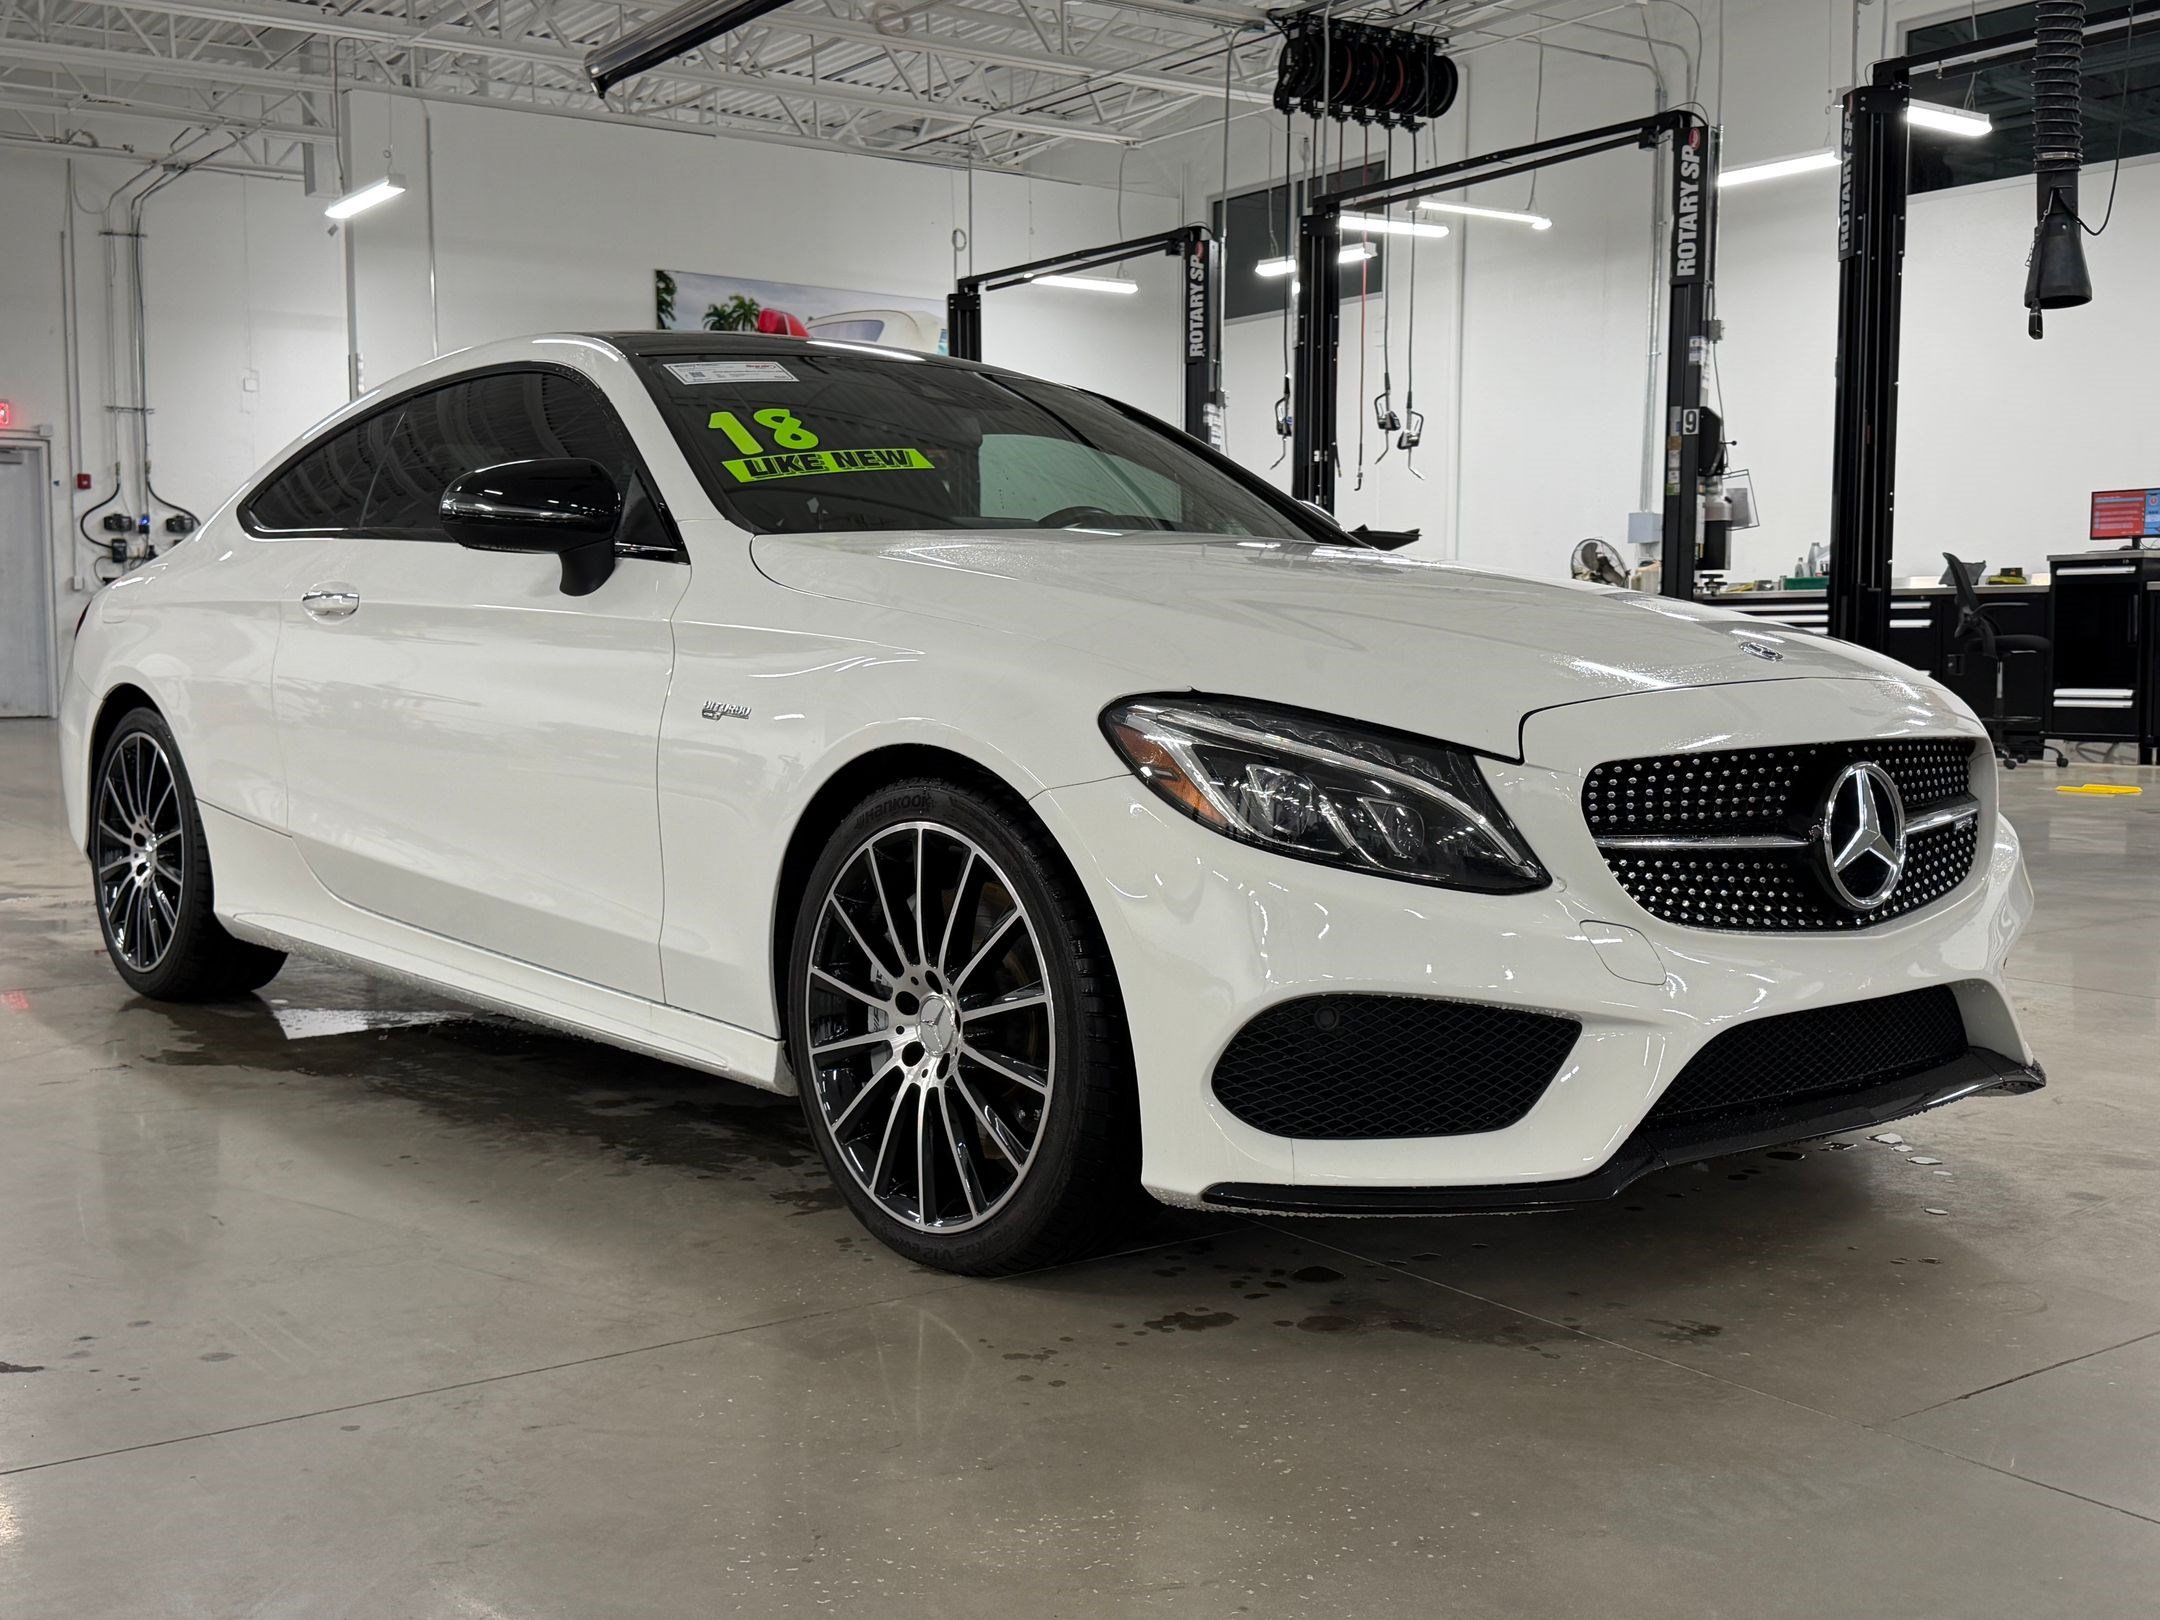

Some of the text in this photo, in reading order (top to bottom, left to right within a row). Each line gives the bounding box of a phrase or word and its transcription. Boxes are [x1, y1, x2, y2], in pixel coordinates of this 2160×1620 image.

[1677, 144, 1701, 276] ROTARY SP
[1840, 150, 1853, 251] ROTARY
[1189, 253, 1204, 357] ROTARY SP
[708, 408, 819, 456] 18
[1685, 410, 1697, 433] 9
[742, 450, 913, 478] LIKE NEW
